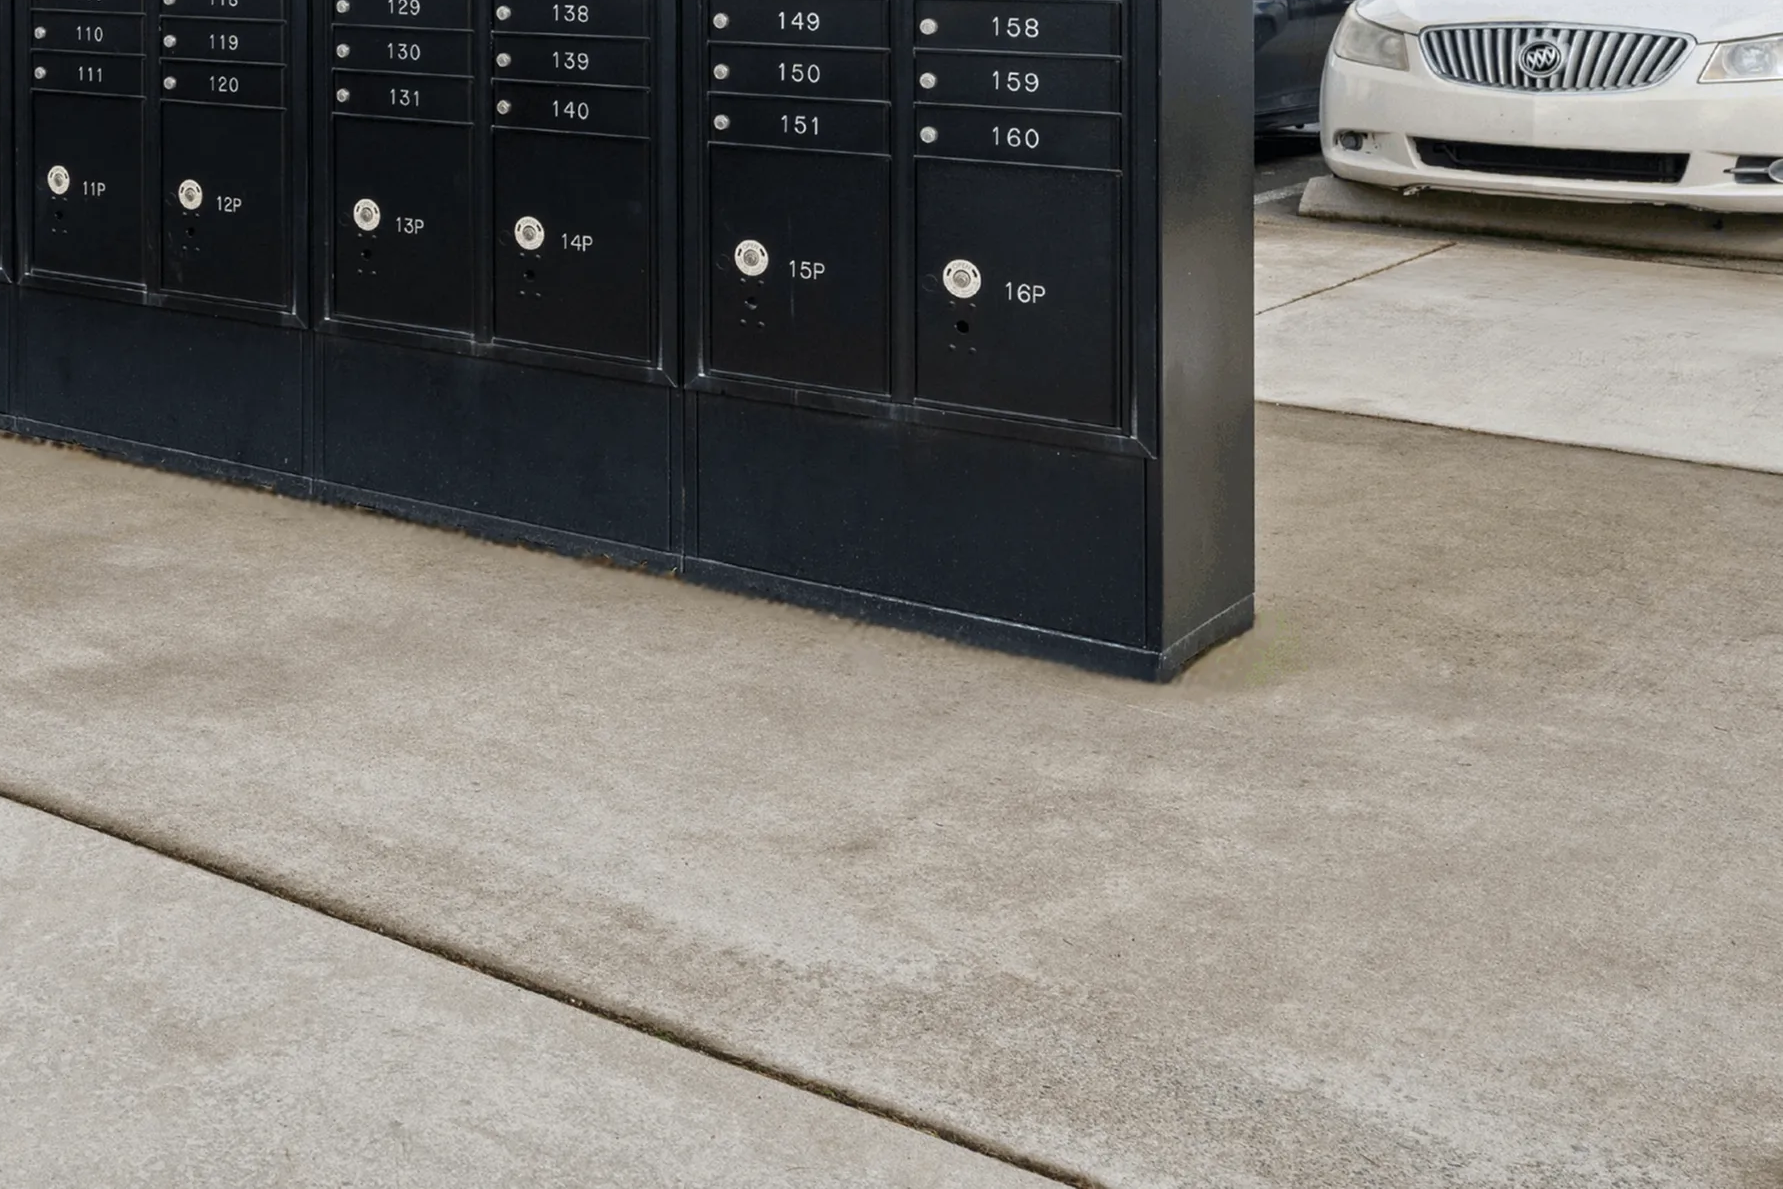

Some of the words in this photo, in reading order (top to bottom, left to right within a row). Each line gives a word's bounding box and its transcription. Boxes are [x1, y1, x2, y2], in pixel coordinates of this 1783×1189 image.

[552, 3, 589, 23] 138
[778, 11, 820, 32] 149
[76, 25, 104, 43] 110
[992, 16, 1039, 38] 158
[209, 33, 239, 51] 119
[387, 42, 421, 61] 130
[552, 51, 589, 71] 139
[78, 66, 102, 83] 111
[778, 62, 821, 84] 150
[992, 70, 1040, 93] 159
[209, 75, 239, 93] 120
[390, 88, 419, 107] 131
[552, 99, 590, 121] 140
[781, 114, 819, 136] 151
[992, 126, 1040, 149] 160
[82, 180, 106, 197] 11P
[216, 195, 242, 213] 12P
[396, 216, 425, 235] 13P
[561, 233, 593, 252] 14P
[789, 259, 826, 280] 15P
[1005, 281, 1046, 304] 16P
